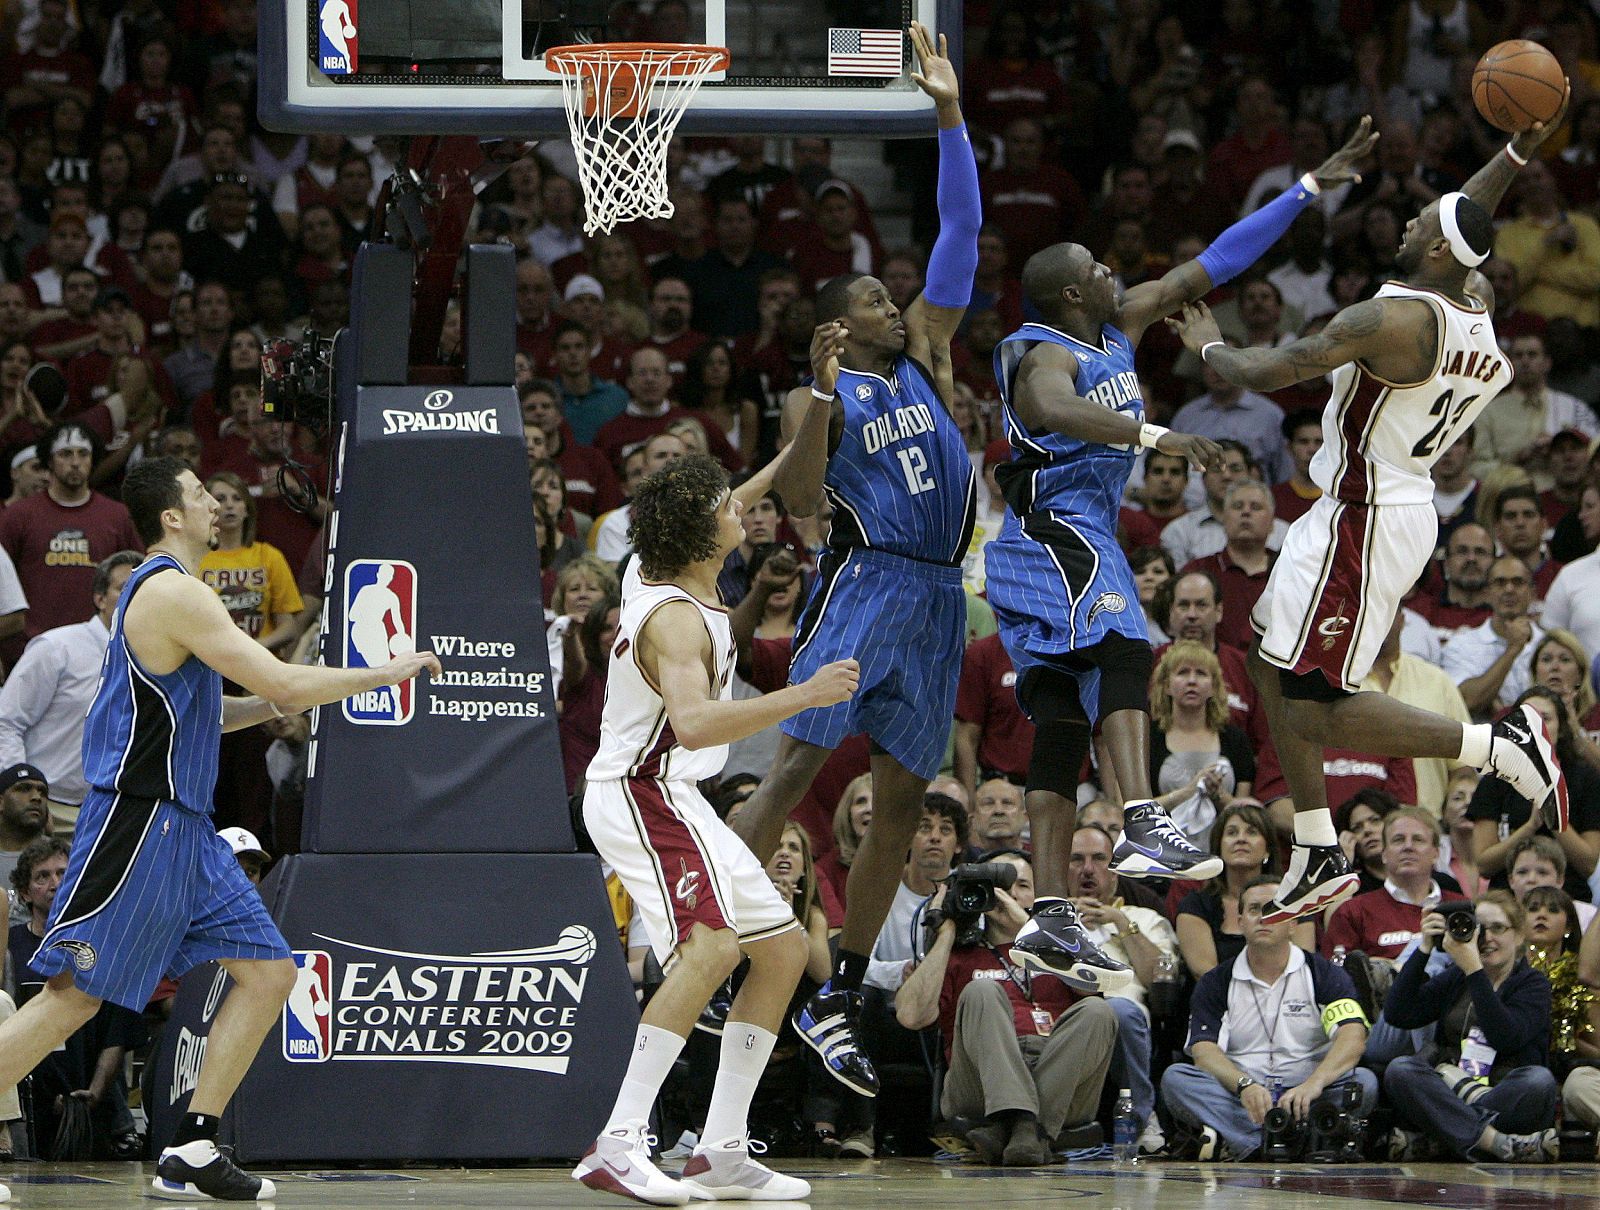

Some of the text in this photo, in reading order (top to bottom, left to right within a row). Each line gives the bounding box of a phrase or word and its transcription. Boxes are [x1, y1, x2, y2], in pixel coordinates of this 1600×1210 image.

[323, 56, 346, 69] NBA
[383, 408, 500, 435] SPALDING
[862, 403, 935, 455] ORLADO
[896, 446, 936, 496] 12
[49, 538, 90, 553] ONE
[202, 567, 264, 588] CAVS
[430, 635, 515, 658] Where
[429, 667, 545, 693] amazing
[352, 690, 392, 713] NBA
[429, 695, 546, 722] happens.
[338, 963, 589, 1004] EASTERN
[337, 1006, 578, 1027] CONFERENCE
[1323, 1002, 1355, 1024] OTO
[289, 1039, 317, 1055] NBA
[334, 1029, 573, 1054] FINALS 2009
